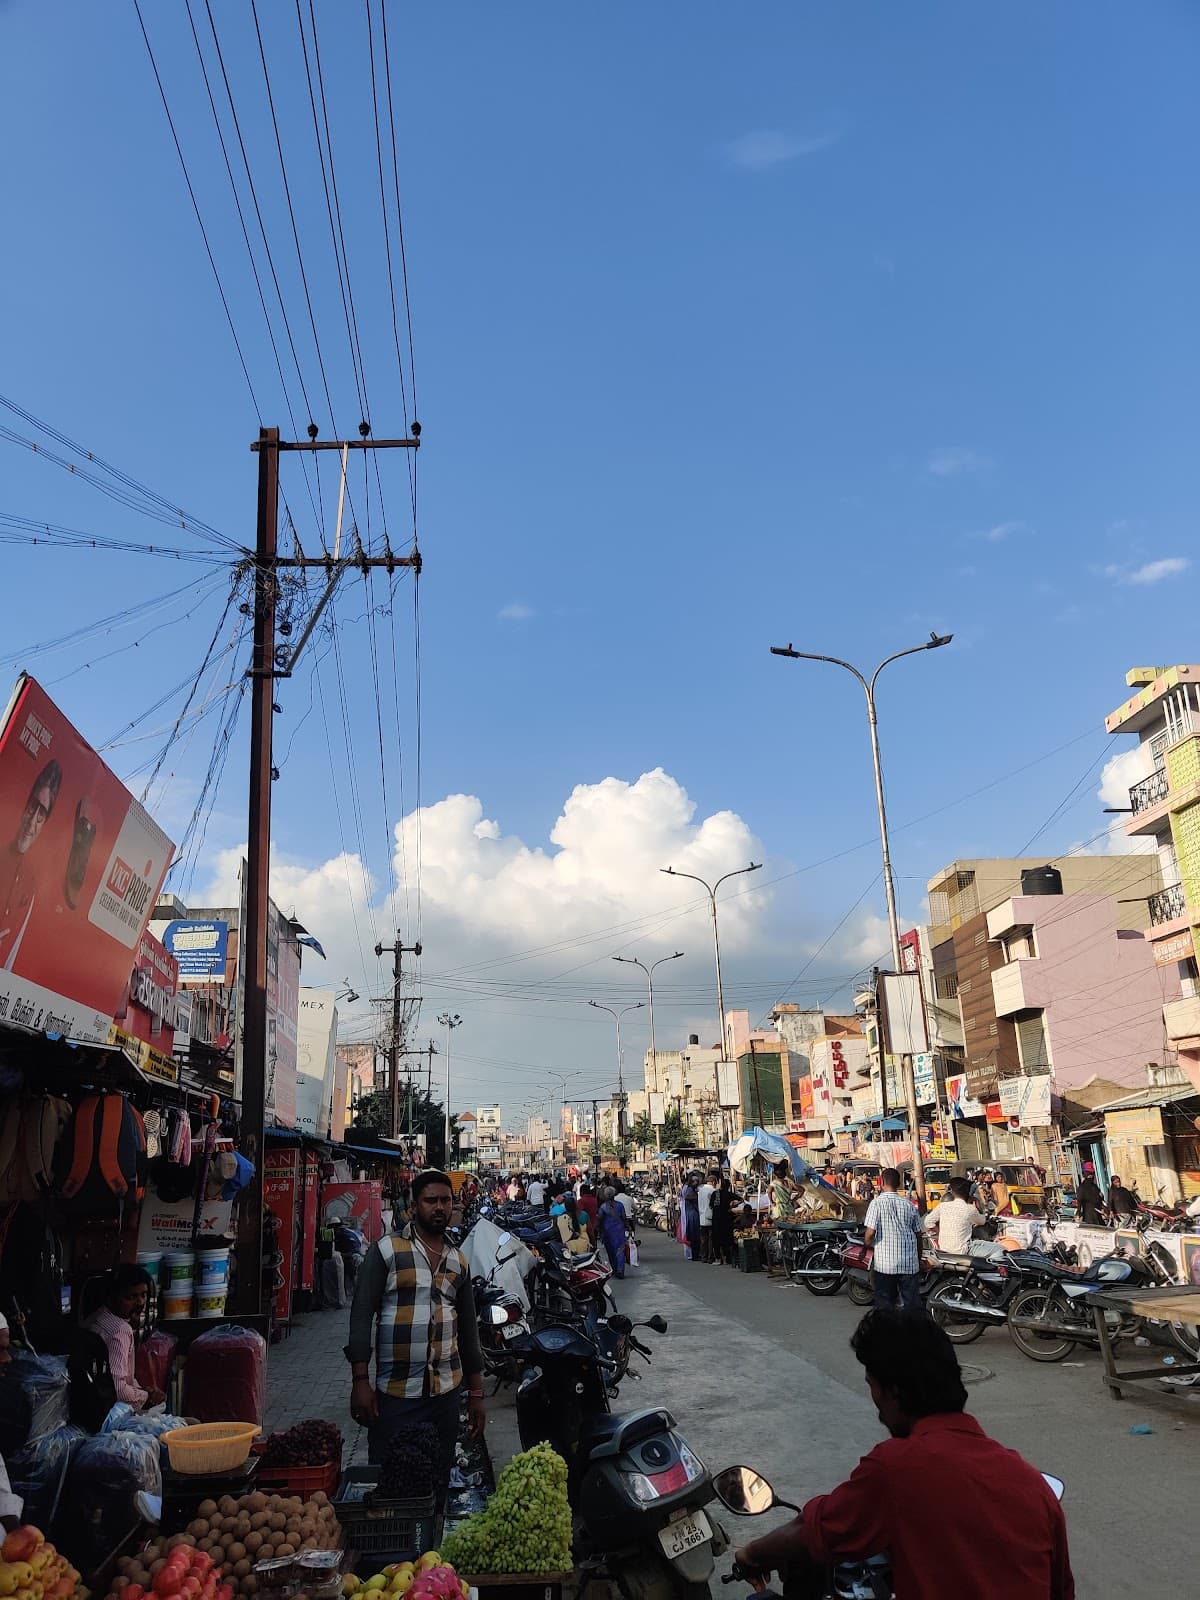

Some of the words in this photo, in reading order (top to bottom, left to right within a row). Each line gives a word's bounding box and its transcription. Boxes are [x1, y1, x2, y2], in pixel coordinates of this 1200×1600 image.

[110, 861, 130, 893] VKC
[124, 872, 151, 915] PRIDE
[301, 1000, 325, 1010] MEX
[34, 1008, 43, 1028] &
[264, 1154, 292, 1167] AN
[264, 1168, 294, 1178] astrack
[672, 1541, 684, 1553] CJ
[685, 1529, 705, 1547] 7661
